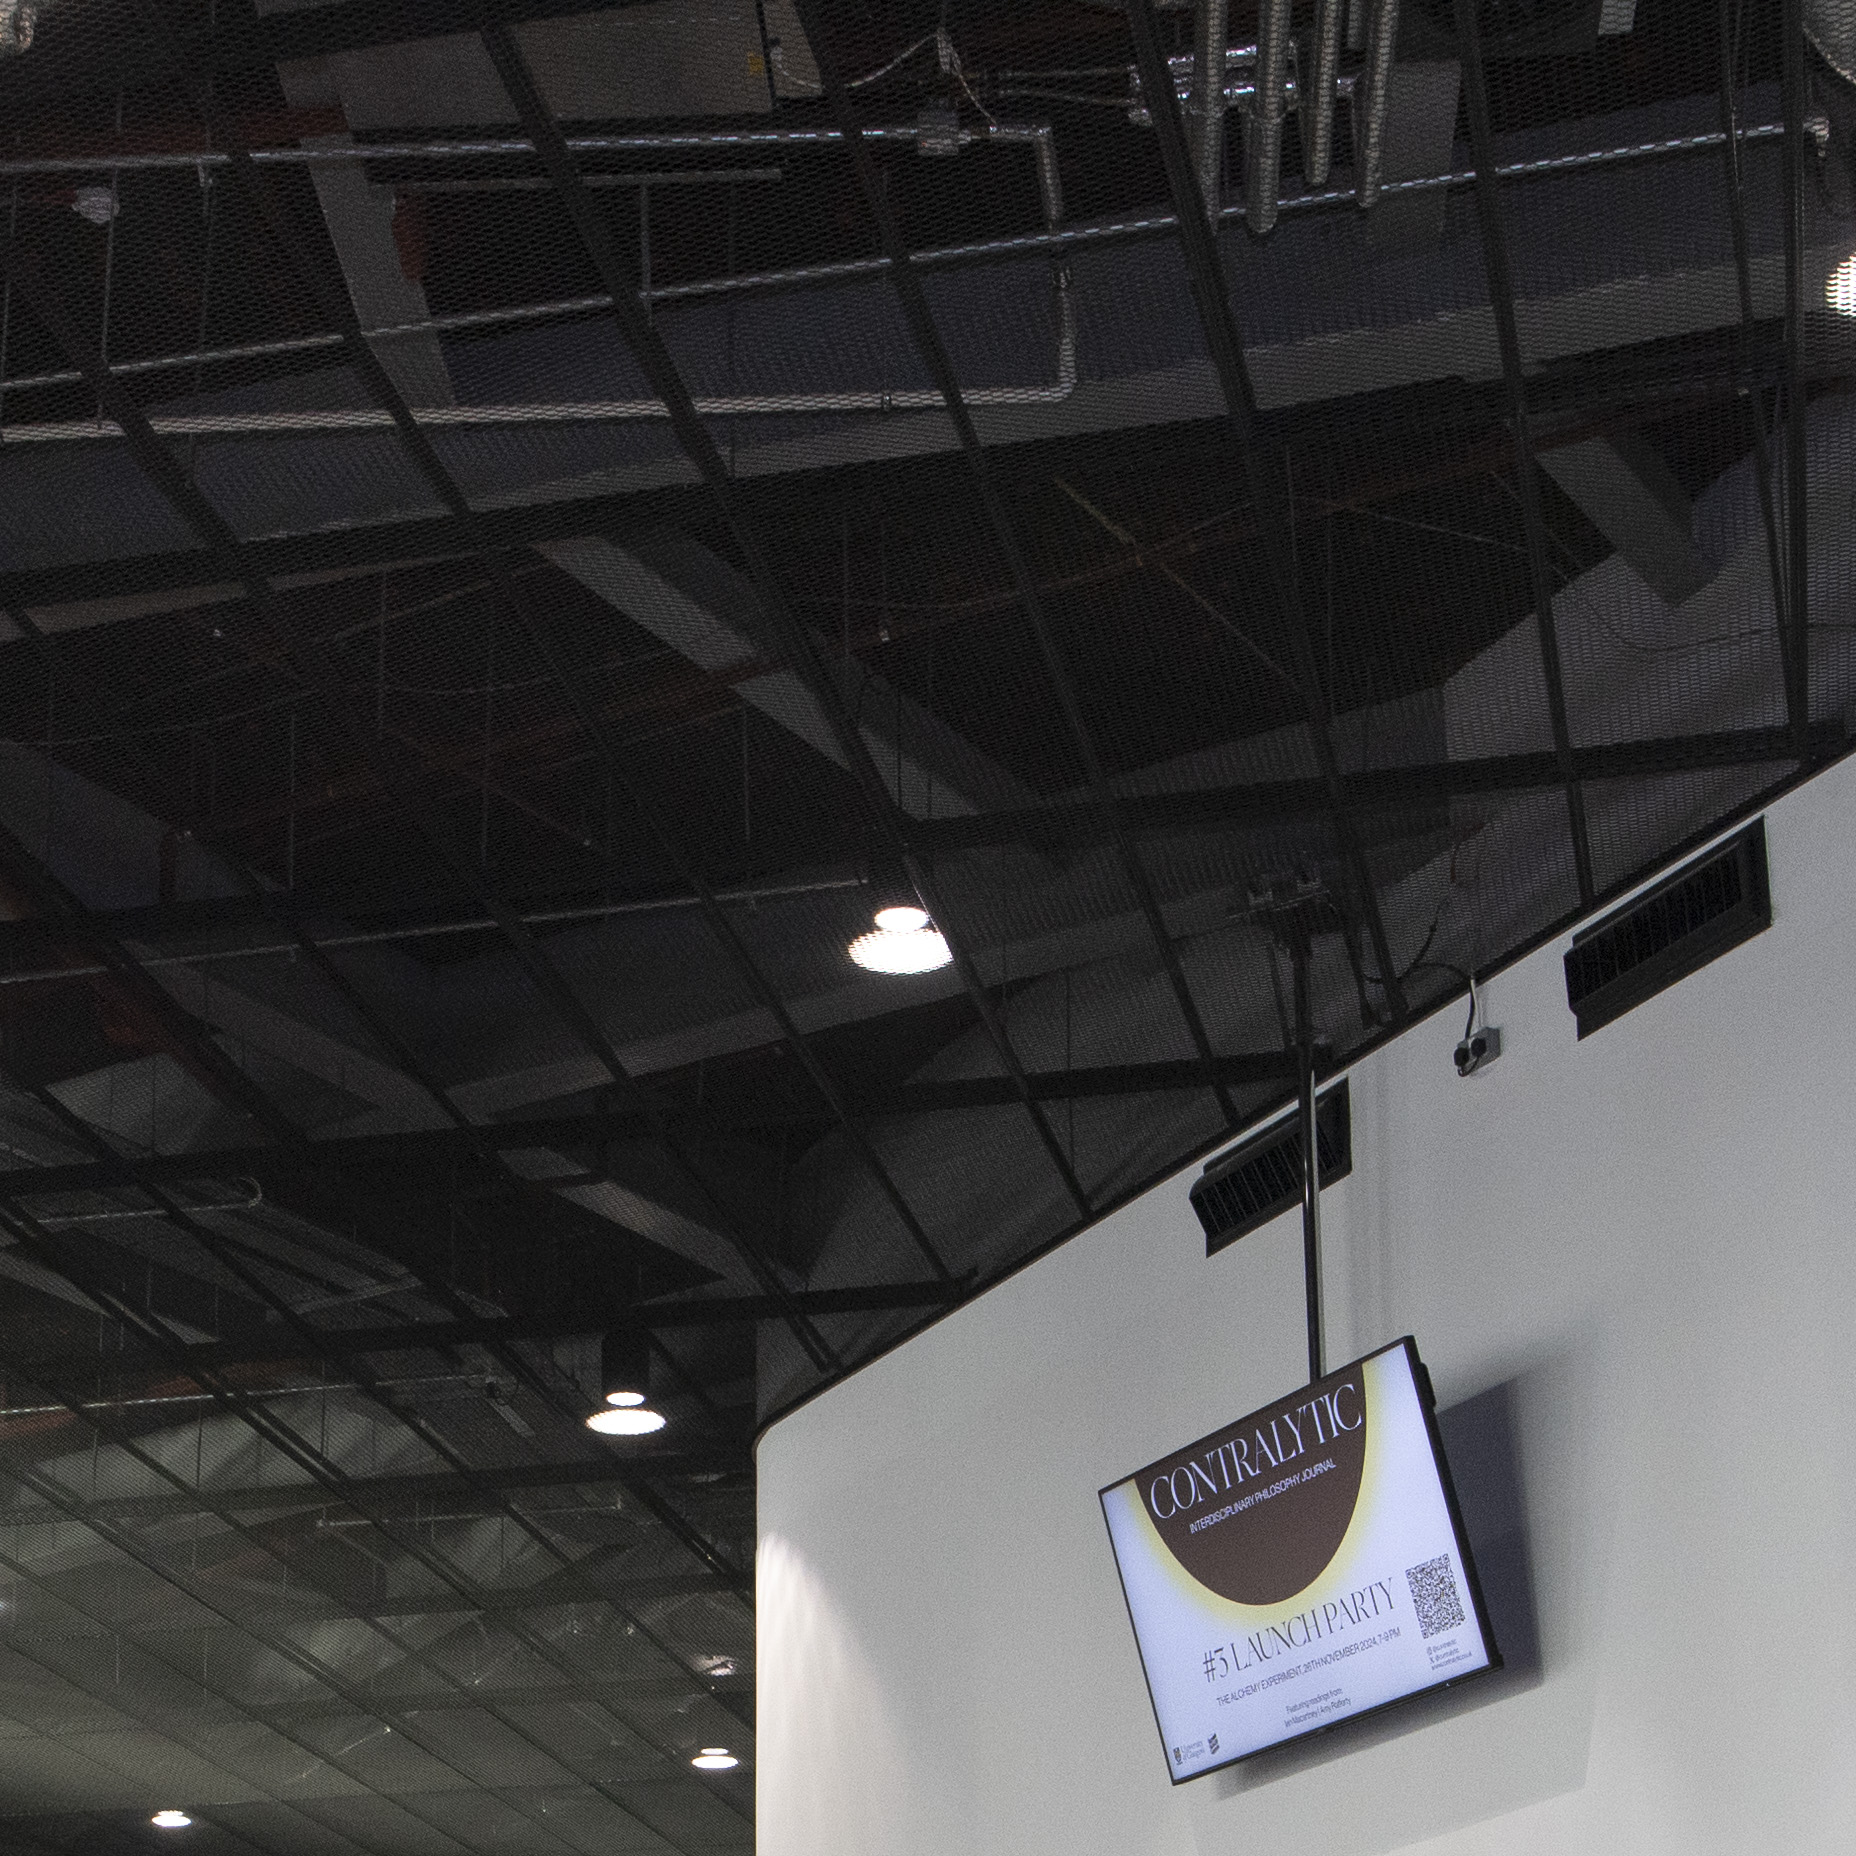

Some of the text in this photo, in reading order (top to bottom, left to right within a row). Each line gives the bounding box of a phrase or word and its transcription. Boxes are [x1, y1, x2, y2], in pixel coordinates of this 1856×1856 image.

[1150, 1384, 1361, 1519] CONTRALYTIC
[1190, 1458, 1337, 1534] INTERDISCIPLINARY PHILOSOPHY JOURNAL
[1230, 1609, 1322, 1672] LAUNCH
[1322, 1577, 1395, 1634] PARTY
